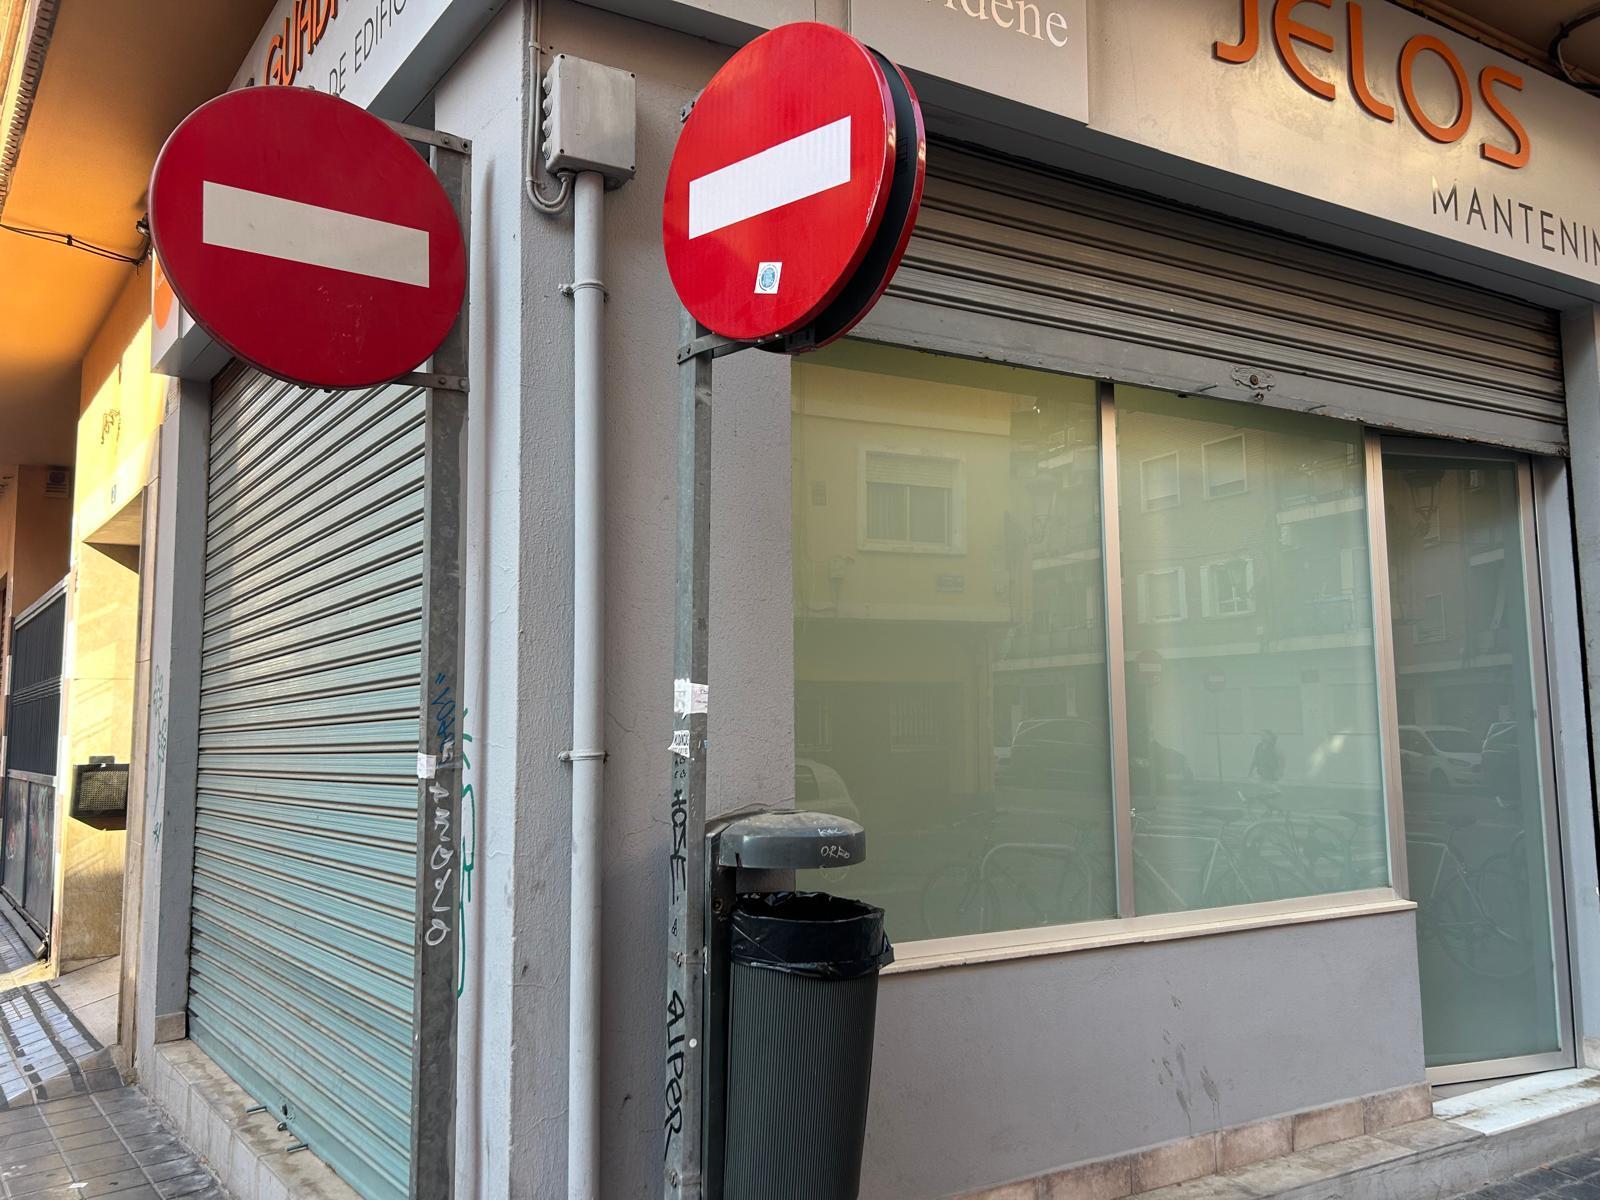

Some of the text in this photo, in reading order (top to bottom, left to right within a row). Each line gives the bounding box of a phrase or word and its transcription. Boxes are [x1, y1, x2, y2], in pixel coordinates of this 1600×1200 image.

[264, 0, 338, 86] GUAD
[329, 52, 347, 94] DE
[1213, 0, 1530, 169] JELOS
